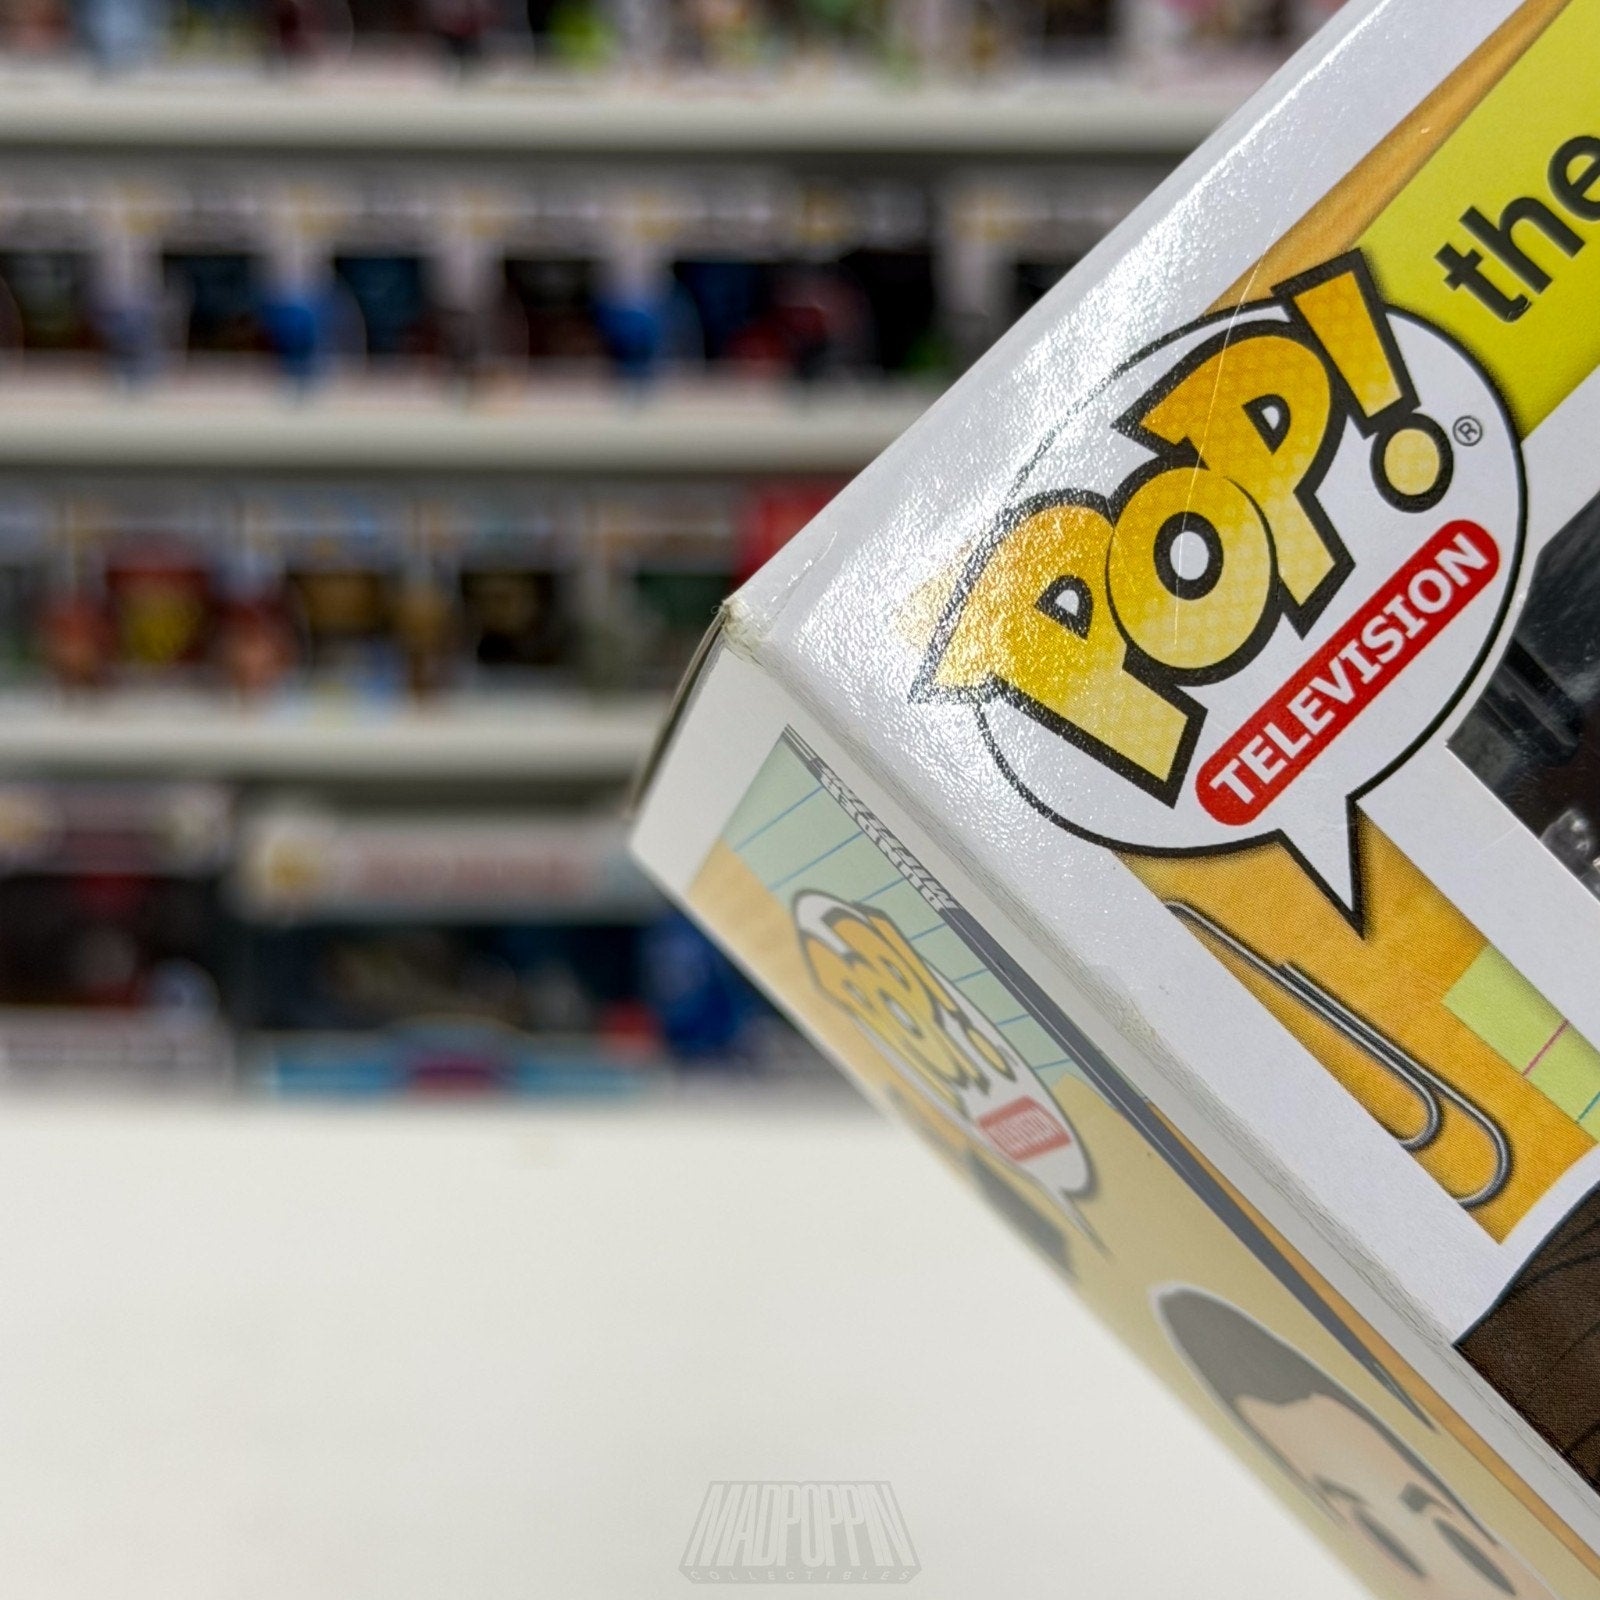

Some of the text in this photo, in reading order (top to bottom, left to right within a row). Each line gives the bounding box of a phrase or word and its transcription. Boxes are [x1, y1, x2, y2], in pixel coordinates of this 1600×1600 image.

[1433, 135, 1600, 322] the
[911, 249, 1454, 809] POP!
[1209, 534, 1490, 806] TELEVISION
